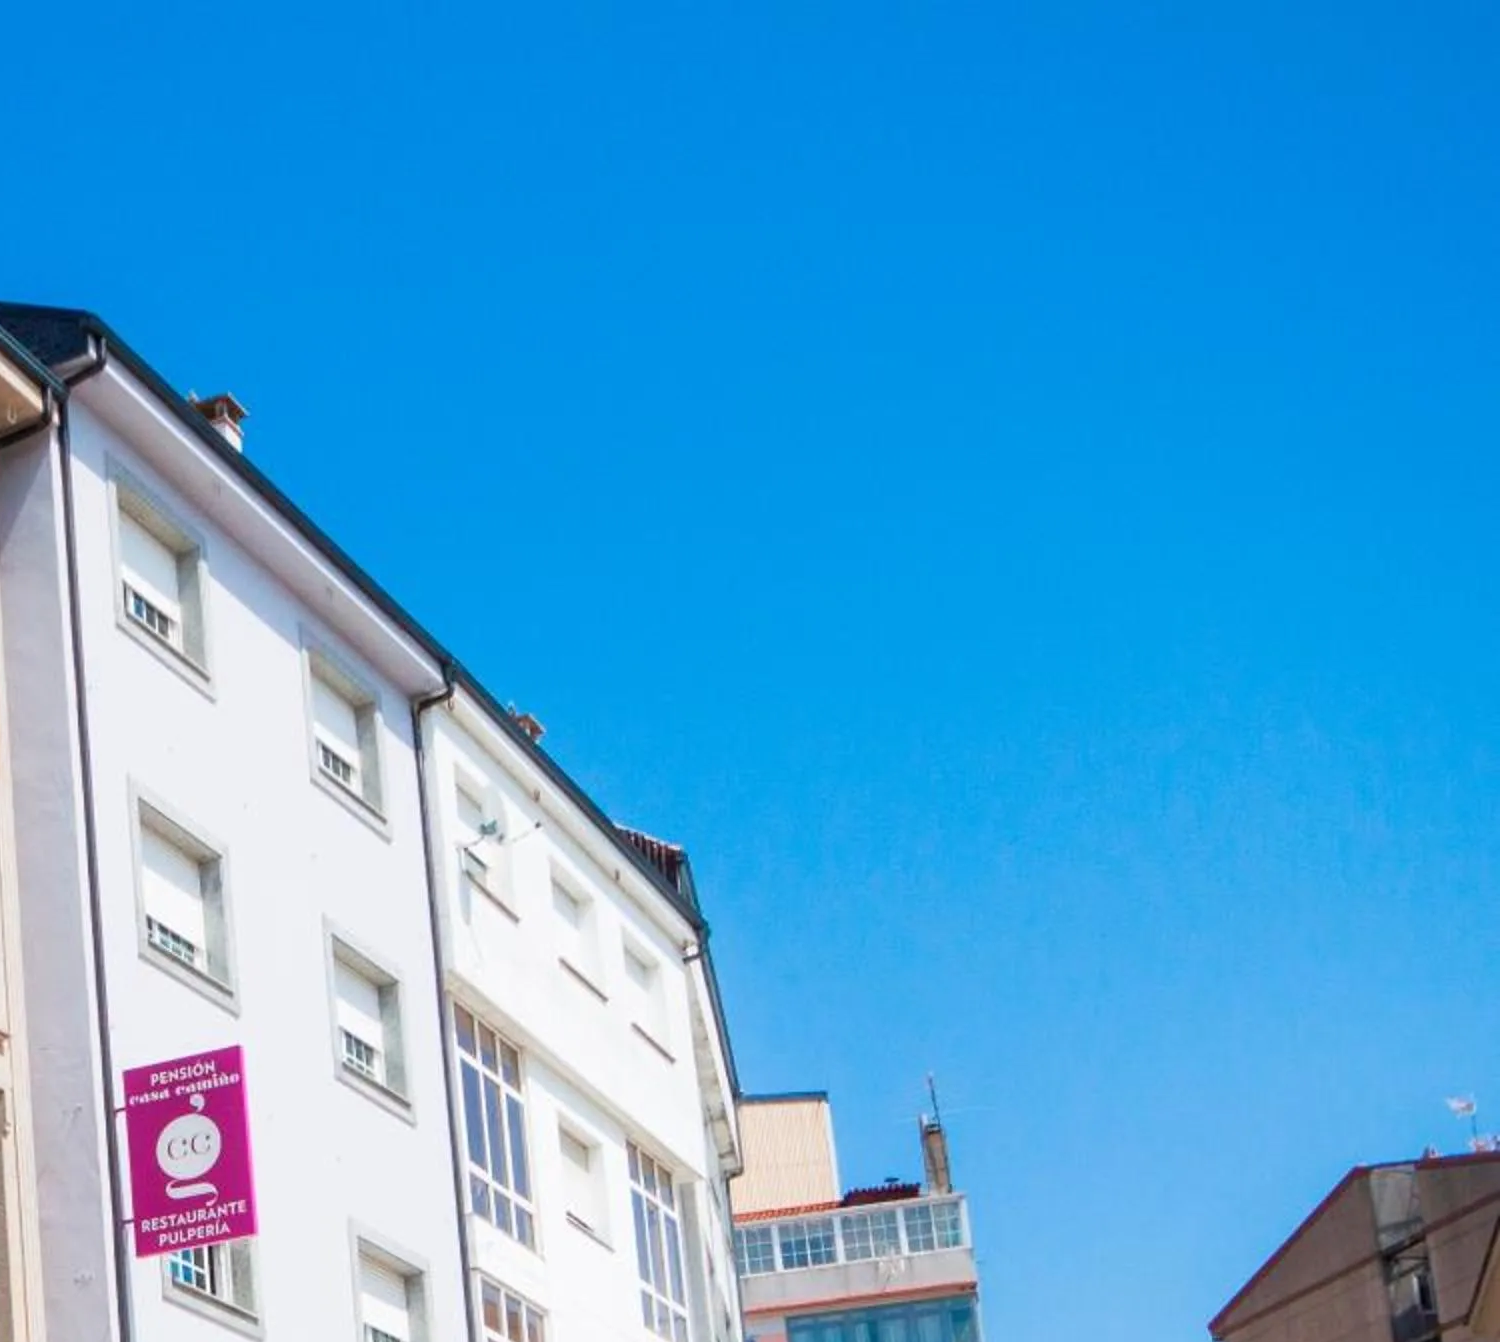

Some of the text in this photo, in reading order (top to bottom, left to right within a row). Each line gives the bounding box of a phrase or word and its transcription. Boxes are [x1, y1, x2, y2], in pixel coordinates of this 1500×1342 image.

[150, 1060, 216, 1087] PENSIÓN
[129, 1072, 240, 1106] casa camiño
[141, 1200, 246, 1233] RESTAURANTE
[158, 1219, 231, 1247] PULPERÍA
